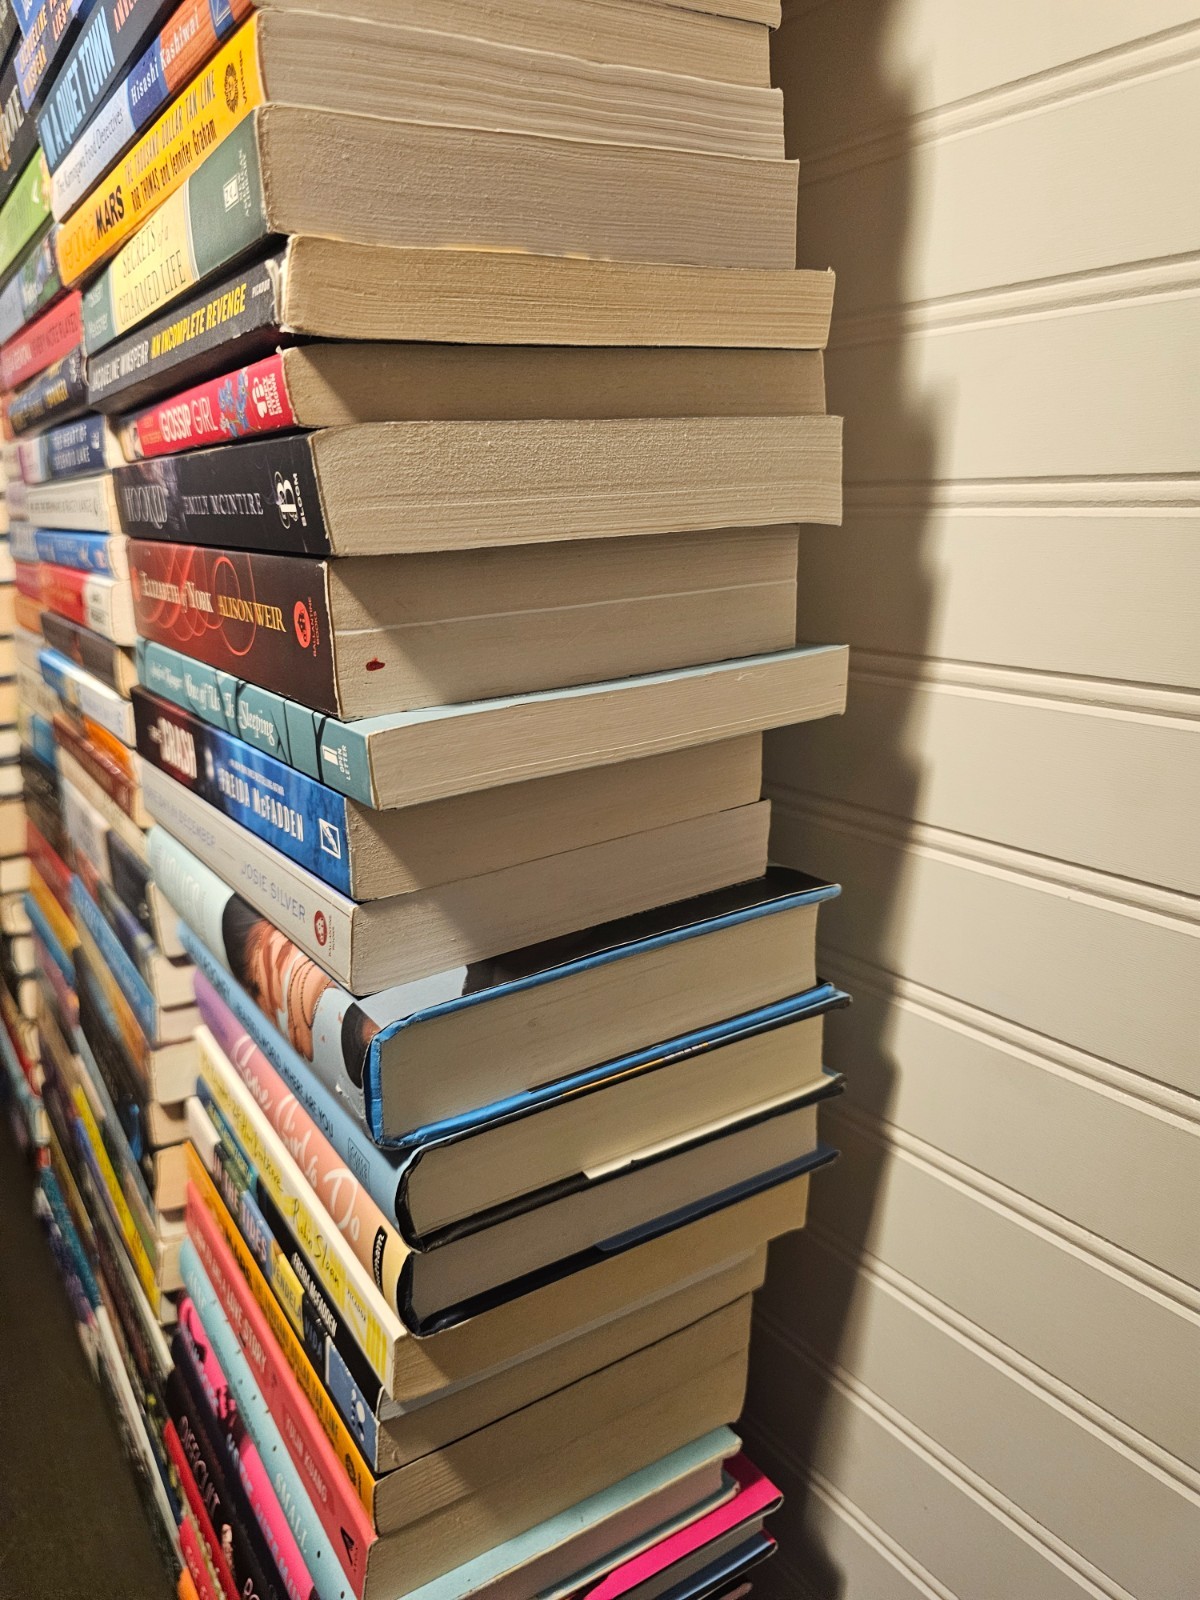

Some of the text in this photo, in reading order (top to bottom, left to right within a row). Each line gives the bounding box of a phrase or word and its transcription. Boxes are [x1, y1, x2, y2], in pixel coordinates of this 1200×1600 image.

[78, 6, 116, 102] TOWN
[130, 6, 200, 106] Hisashi Kashiwai
[50, 103, 65, 155] A
[56, 58, 86, 145] QUIET
[134, 130, 160, 176] THOUSAND
[161, 105, 184, 150] DOLLAR
[185, 87, 198, 124] TAN
[200, 69, 216, 110] LINE
[130, 118, 218, 213] ROB THOMAS and Jennifer Graham
[95, 184, 125, 240] MARS
[122, 219, 156, 279] SECRETS
[119, 269, 160, 326] CHARMED
[160, 249, 187, 295] LIFE
[151, 334, 161, 360] AN
[160, 307, 206, 355] INCOMPLETE
[206, 283, 248, 332] REVENGE
[158, 403, 193, 443] GOSSIP
[192, 396, 219, 434] GIRL
[124, 485, 168, 530] HOOKED
[182, 495, 210, 515] EMILY
[210, 492, 264, 516] MCINTIRE
[292, 472, 307, 526] BLOOM
[216, 594, 254, 623] ALISON
[252, 602, 288, 633] WEIR
[308, 596, 316, 657] BALLANTINE
[238, 700, 274, 746] Sleeping
[337, 748, 345, 773] OPEN
[342, 744, 351, 781] LETTER
[218, 767, 250, 808] FREIDA
[252, 786, 304, 842] McFADDEN
[240, 863, 269, 894] JOSIE
[270, 882, 306, 924] SILVER
[318, 1107, 334, 1140] YOU
[292, 1197, 314, 1250] Robin
[314, 1234, 341, 1289] Sloan
[240, 1207, 267, 1263] TIDES
[304, 1322, 323, 1362] VIDA
[290, 1251, 338, 1337] FREIDA McFADDEN
[242, 1319, 268, 1374] STORY
[285, 1412, 304, 1458] YULIN
[304, 1453, 328, 1503] KUANG
